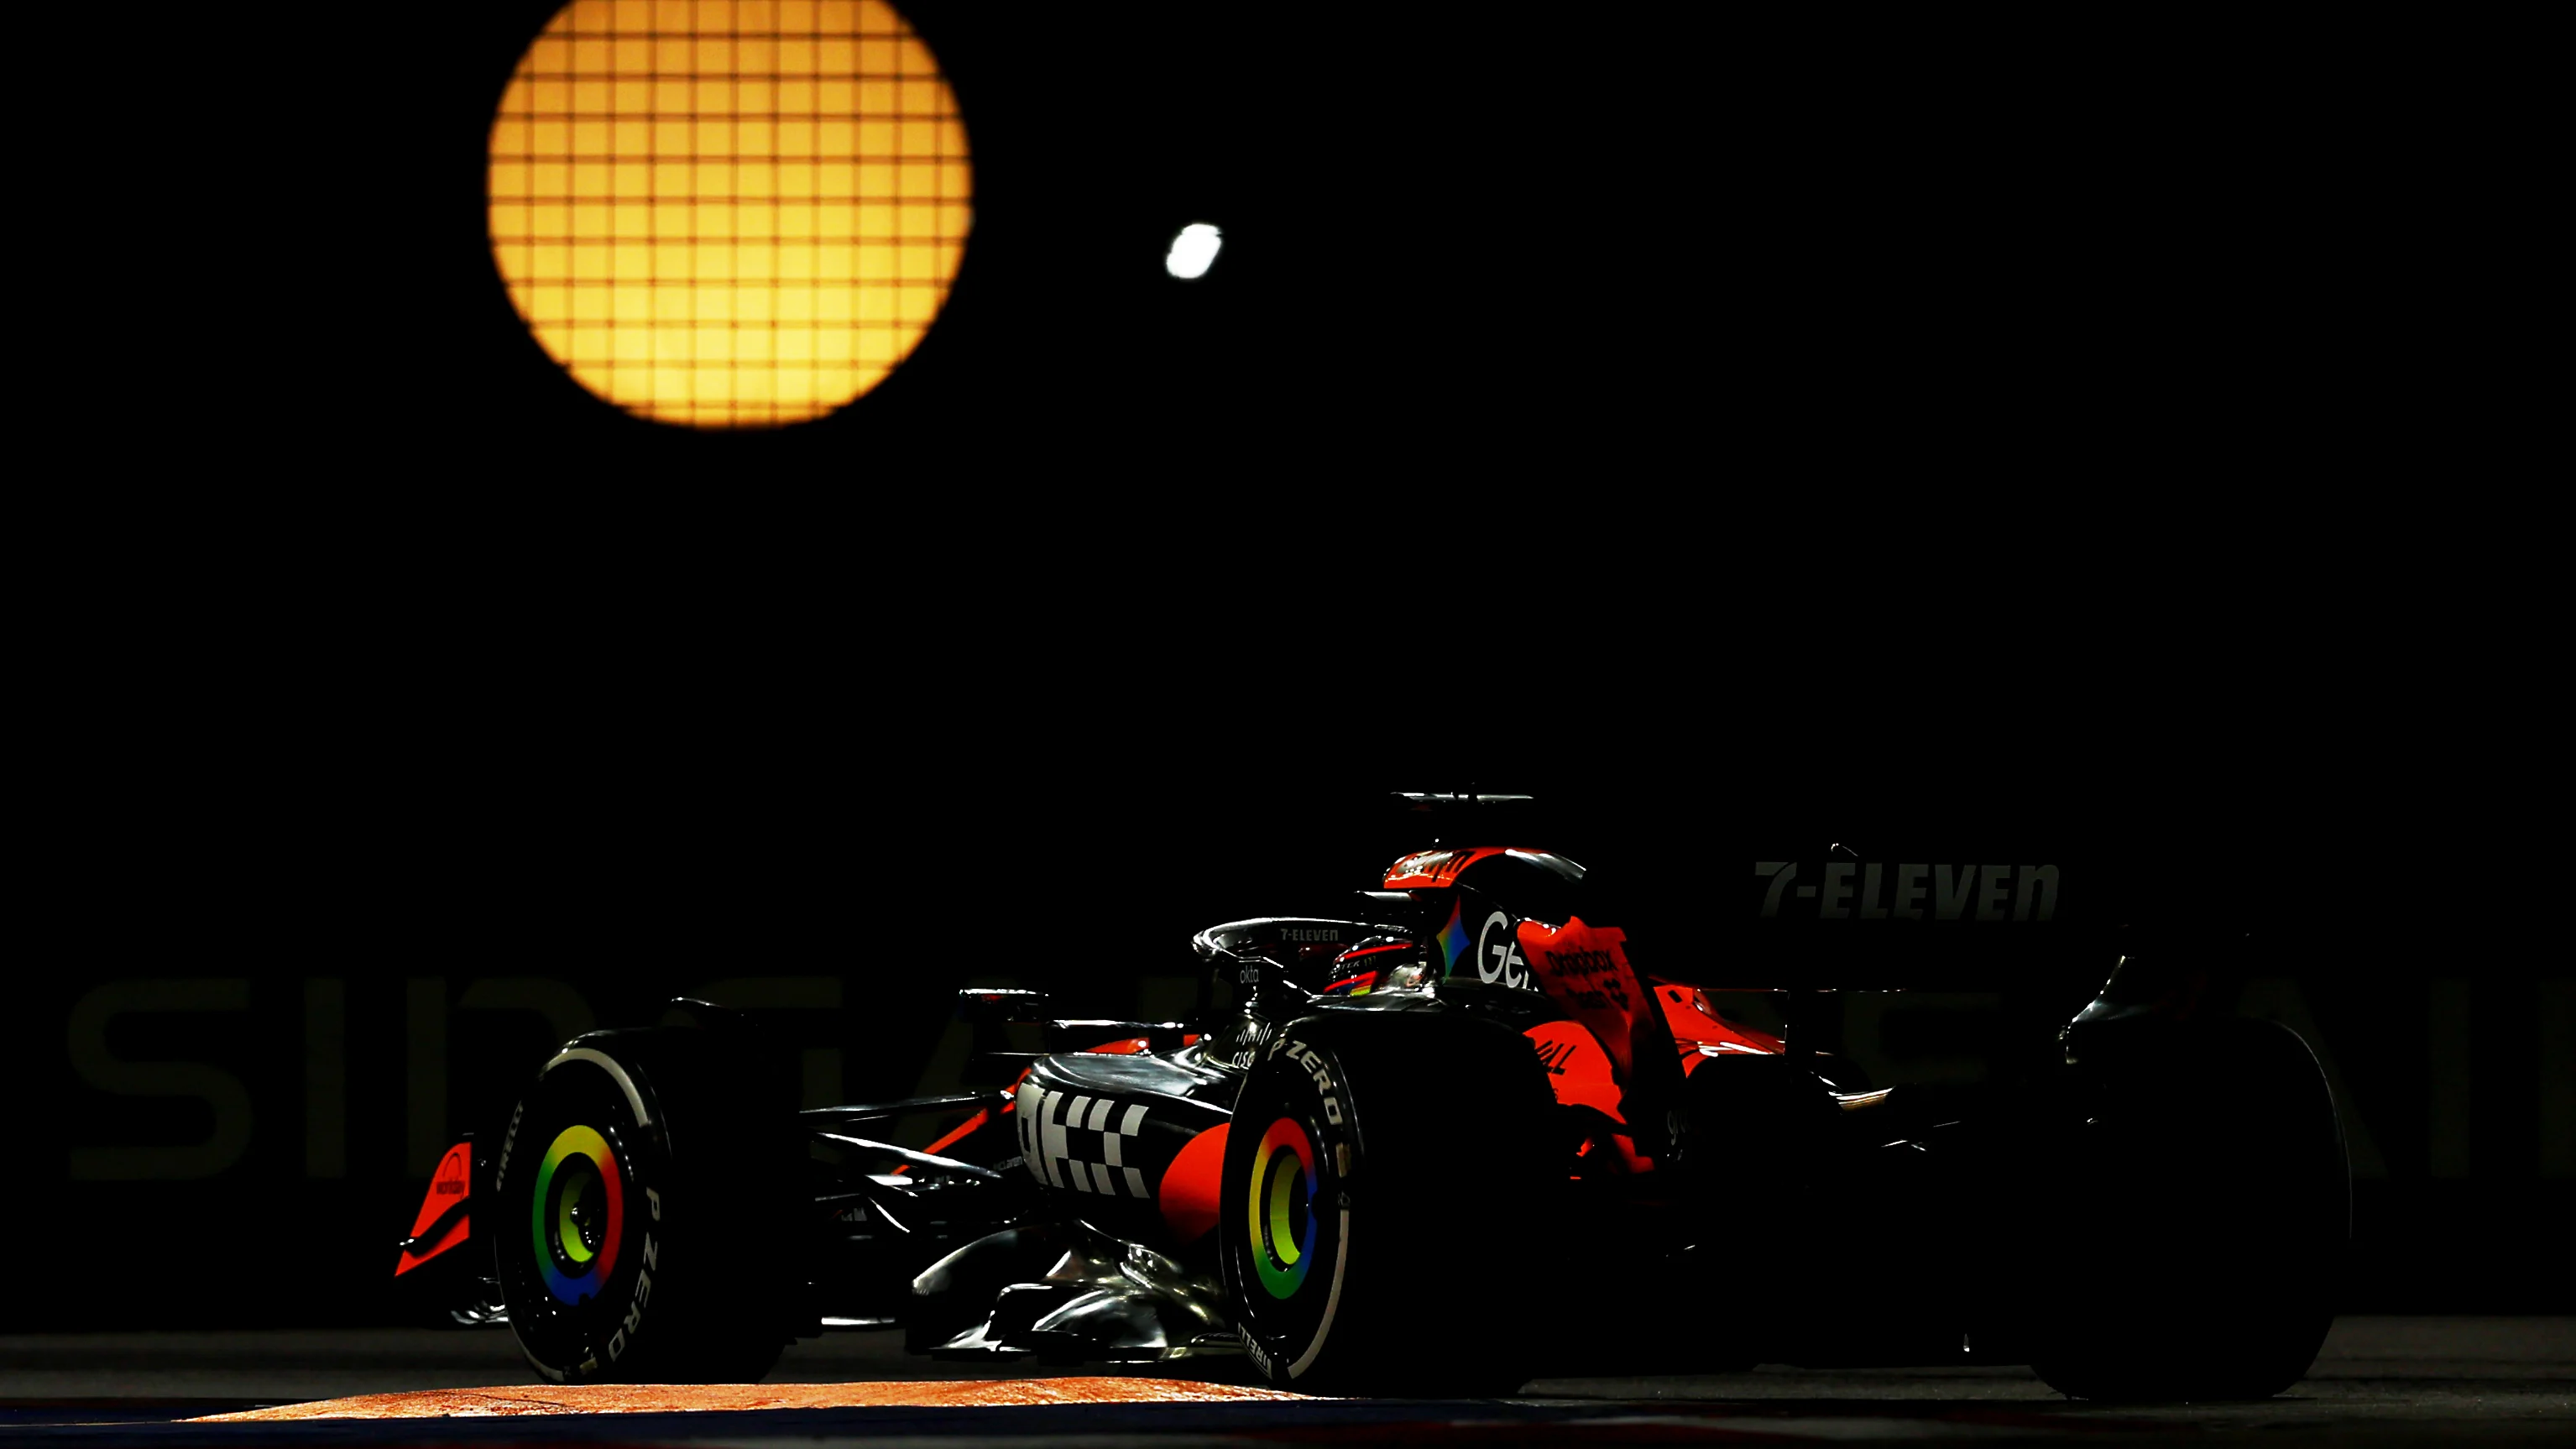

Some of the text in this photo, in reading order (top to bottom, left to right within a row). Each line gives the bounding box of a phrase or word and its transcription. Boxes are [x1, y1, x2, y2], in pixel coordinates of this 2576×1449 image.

[1239, 964, 1260, 984] okta
[1285, 1039, 1344, 1126] ZERO
[1016, 1082, 1151, 1200] OKX
[608, 1186, 661, 1363] P ZERO
